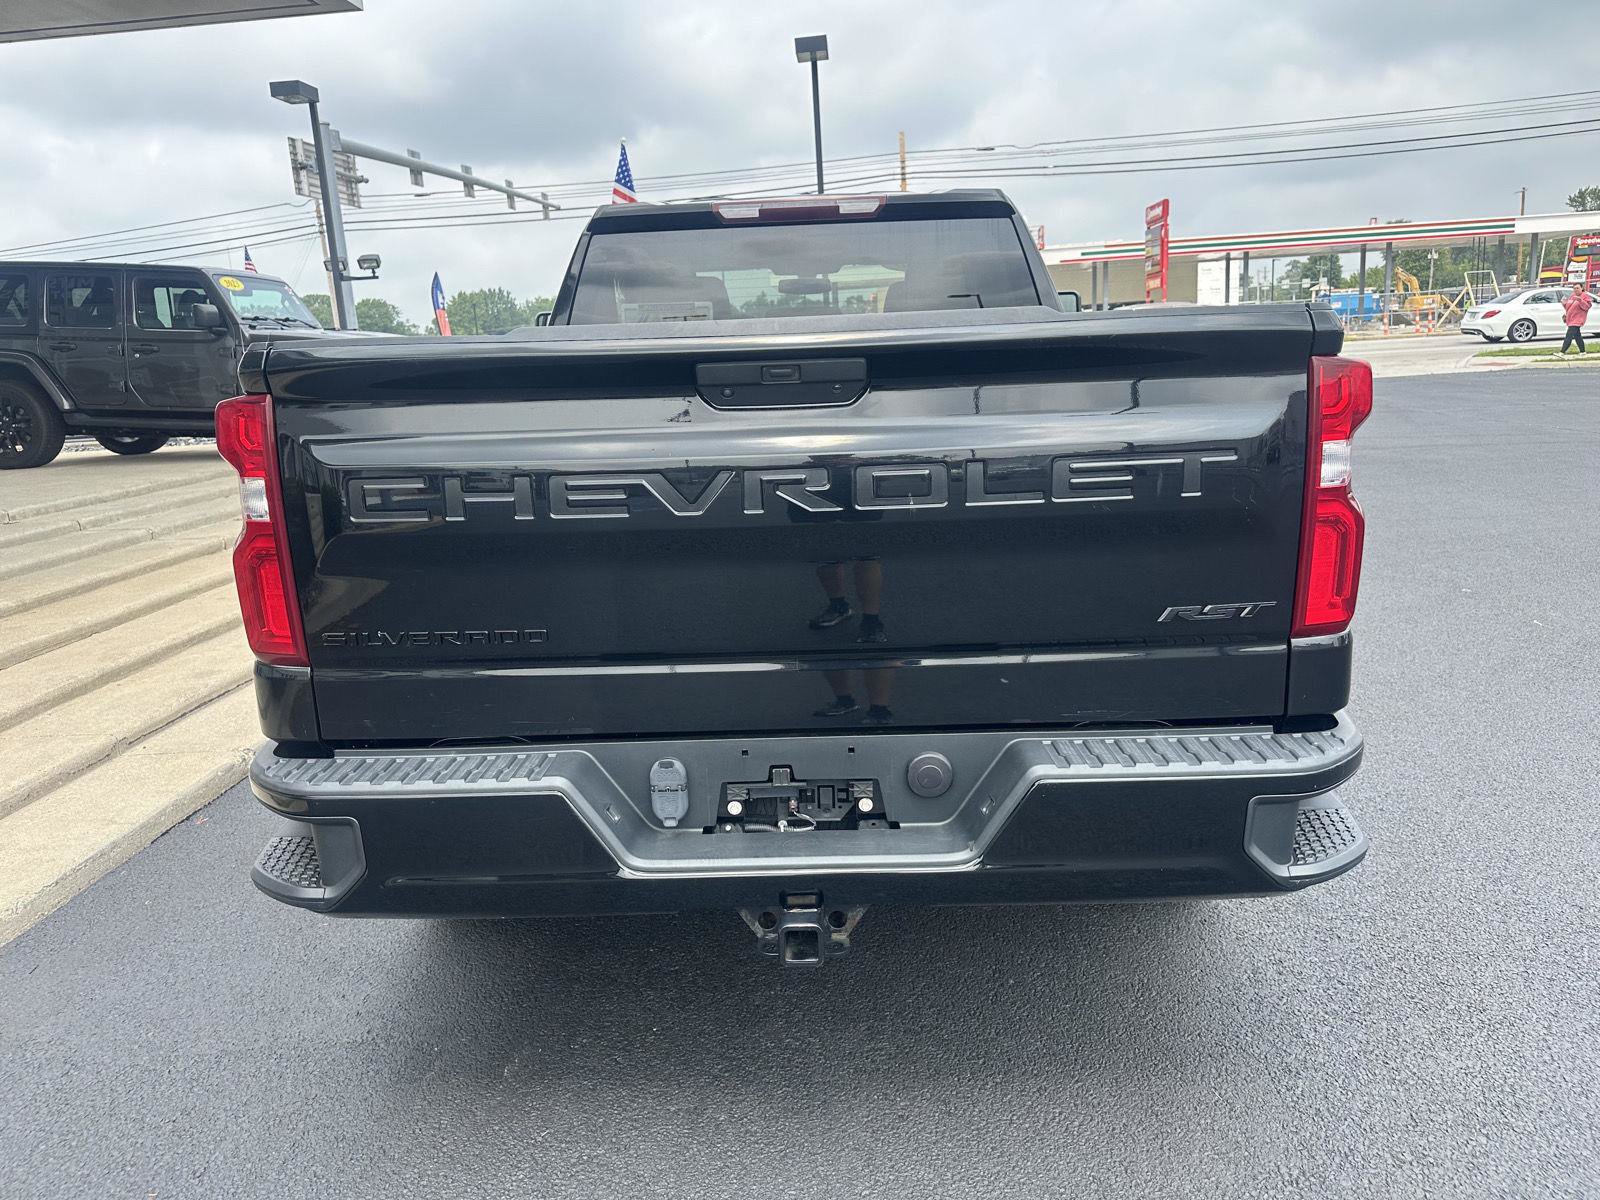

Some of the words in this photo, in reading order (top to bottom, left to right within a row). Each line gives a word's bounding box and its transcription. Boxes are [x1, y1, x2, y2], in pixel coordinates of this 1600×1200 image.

[347, 448, 1238, 522] CHEVROLET
[1157, 601, 1277, 622] RST
[321, 628, 549, 646] SILVERADO
